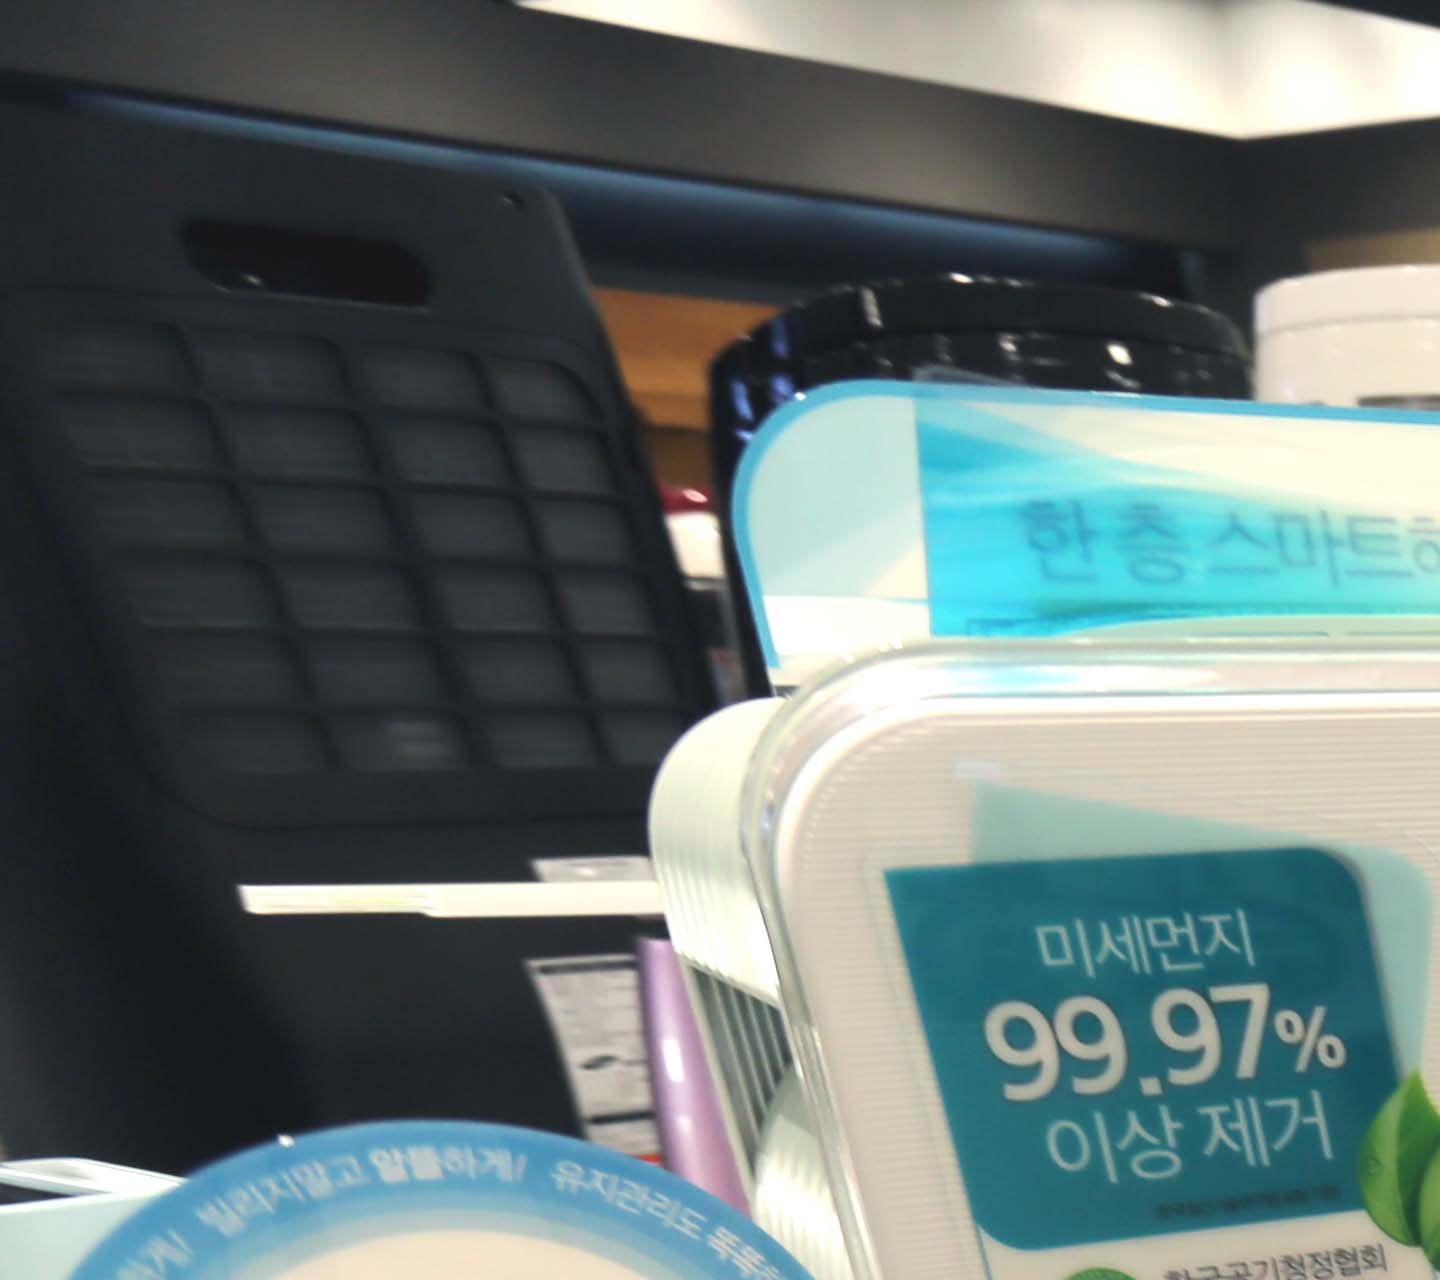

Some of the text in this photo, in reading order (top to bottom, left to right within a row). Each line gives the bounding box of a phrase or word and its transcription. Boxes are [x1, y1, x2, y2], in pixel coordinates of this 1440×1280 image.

[1036, 909, 1256, 978] 미세먼지
[984, 982, 1348, 1103] 99.97%
[1047, 1090, 1334, 1185] 이상 제거
